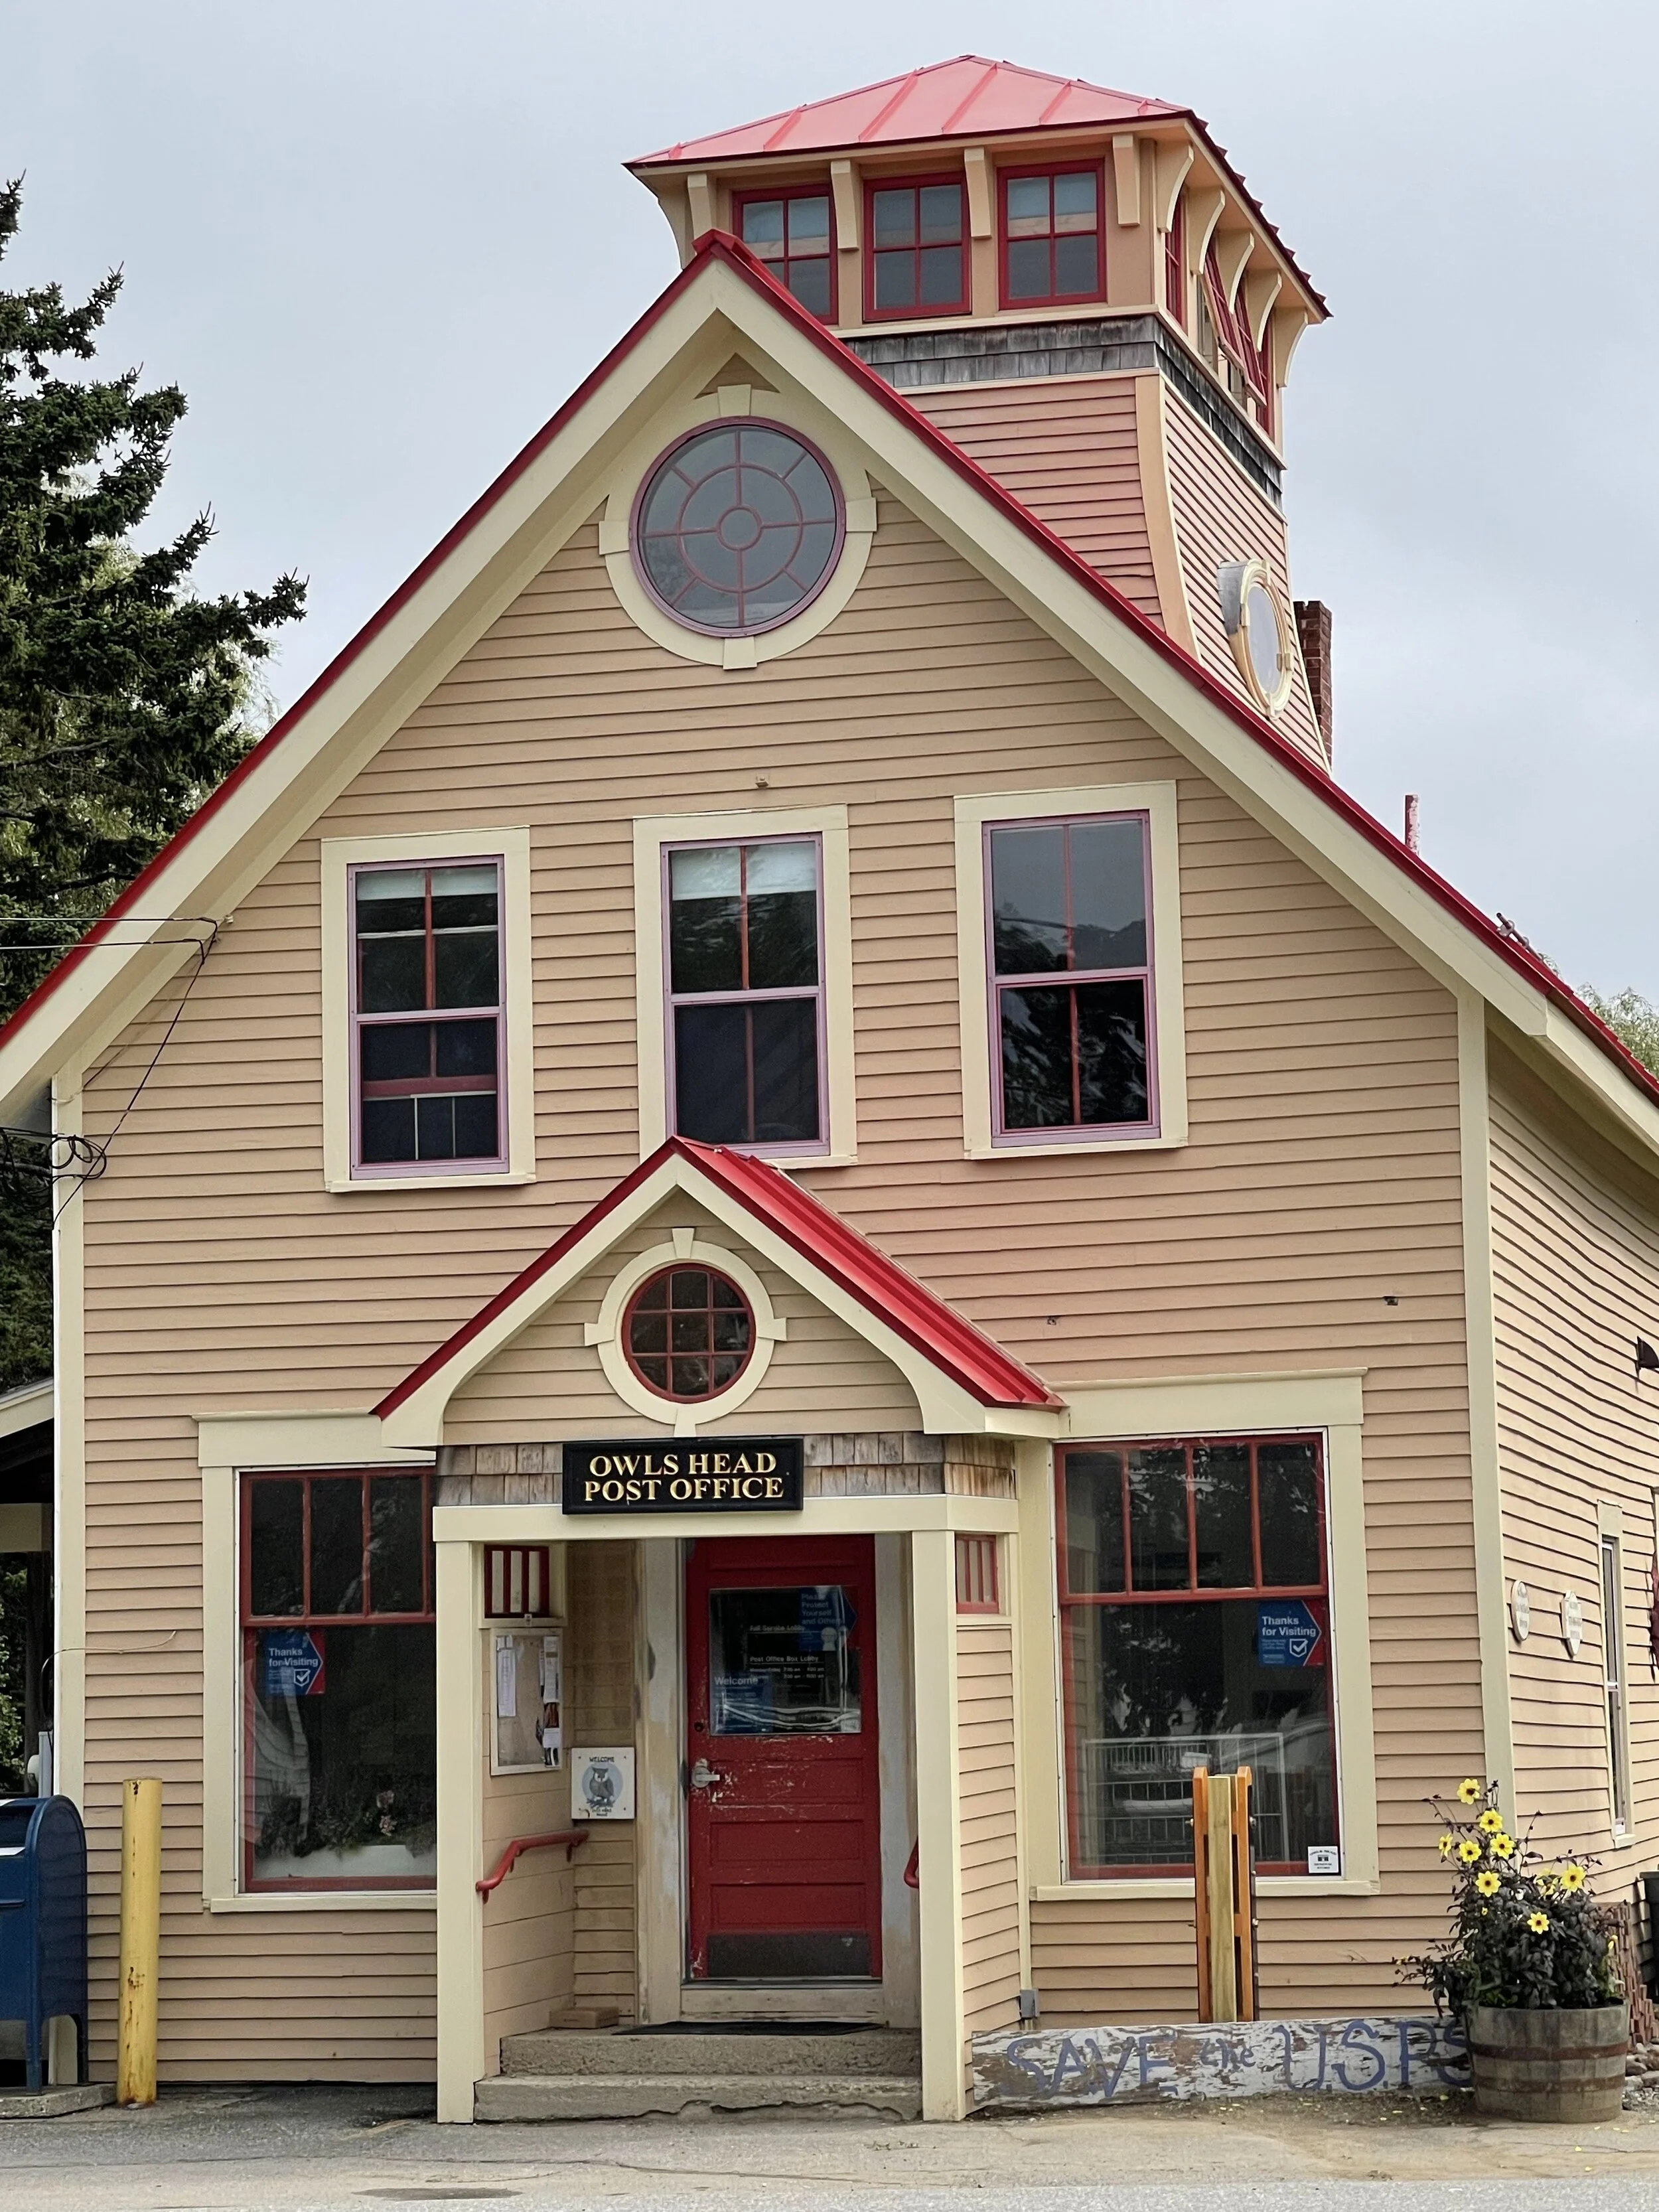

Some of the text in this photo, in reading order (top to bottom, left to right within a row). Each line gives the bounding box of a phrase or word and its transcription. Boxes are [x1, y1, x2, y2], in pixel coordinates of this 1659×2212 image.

[589, 1453, 777, 1477] OWLS HEAD
[584, 1477, 784, 1501] POST OFFICE
[1262, 1616, 1299, 1625] Thanks
[1262, 1627, 1317, 1637] for Visiting
[269, 1647, 303, 1657] Thanks
[269, 1658, 319, 1667] for Visiting
[714, 1676, 758, 1686] Welcome
[998, 2032, 1177, 2098] SAVE
[1200, 2037, 1256, 2071] the
